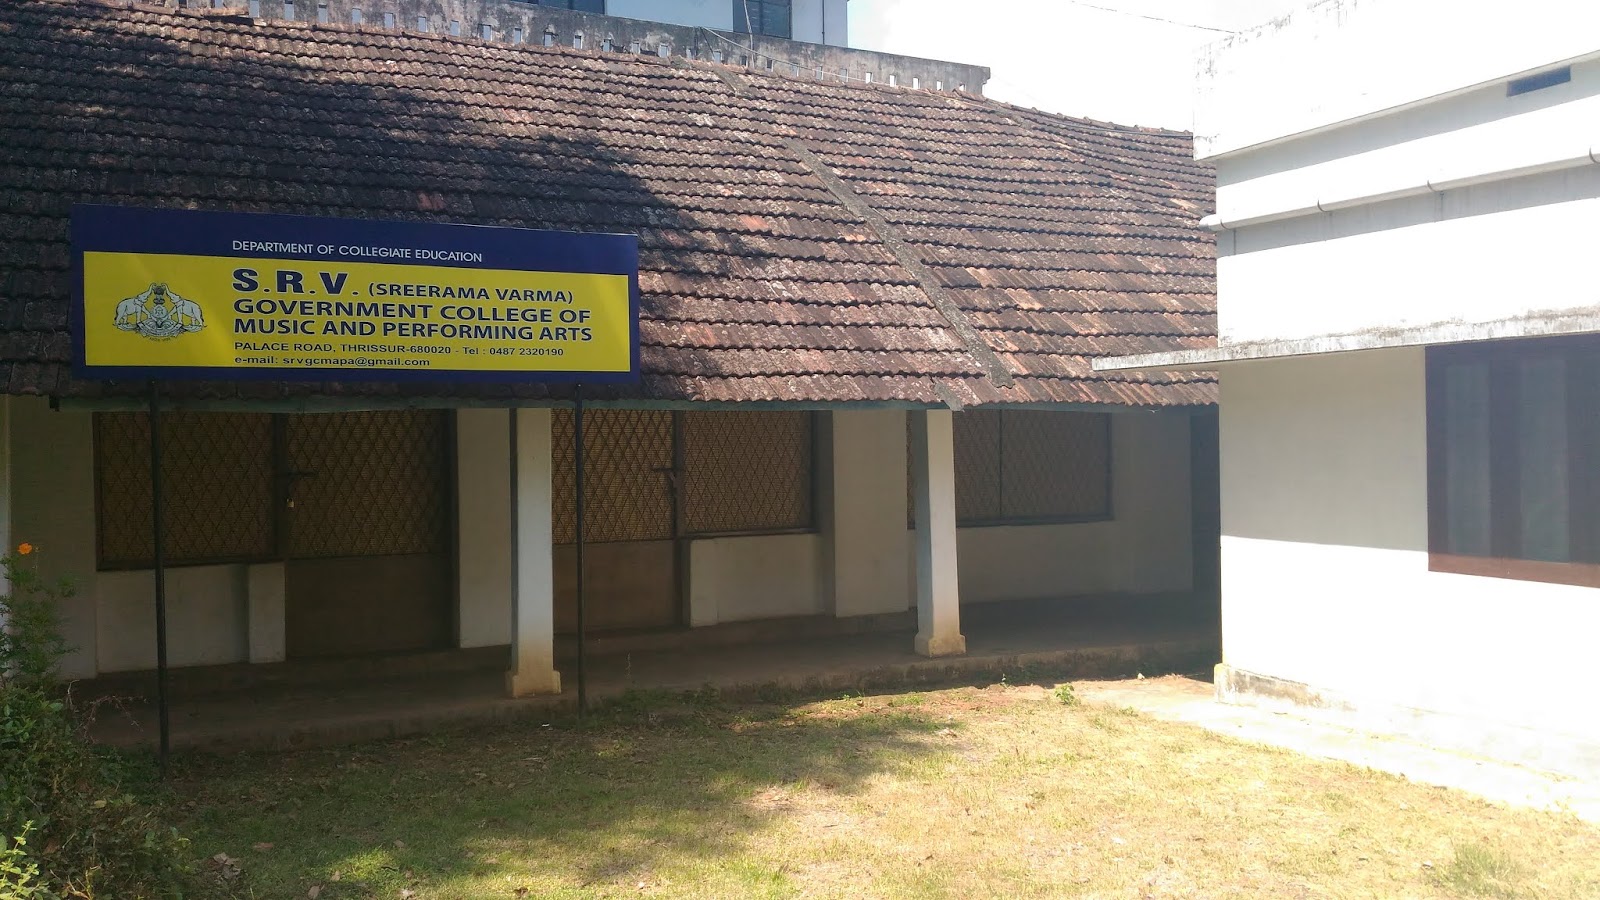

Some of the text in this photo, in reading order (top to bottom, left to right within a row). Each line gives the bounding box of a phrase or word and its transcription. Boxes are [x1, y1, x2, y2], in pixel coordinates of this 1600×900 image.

[232, 240, 482, 263] DEPARTMENT OF COLLEGIATE EDUCATION
[232, 268, 573, 304] S.R.V. (SREERAMA VARMA)
[233, 299, 591, 324] GOVERNMENT COLLEGE OF
[234, 318, 592, 341] MUSIC AND PERFORMING ARTS
[234, 342, 289, 351] PALACE
[293, 343, 336, 353] ROAD,
[340, 343, 451, 354] THRISSUR-680020
[462, 347, 479, 355] Tel
[489, 347, 515, 356] 0487
[519, 348, 564, 356] 2320190
[234, 356, 430, 366] e-mail: srvgcmapa@gmail.com
